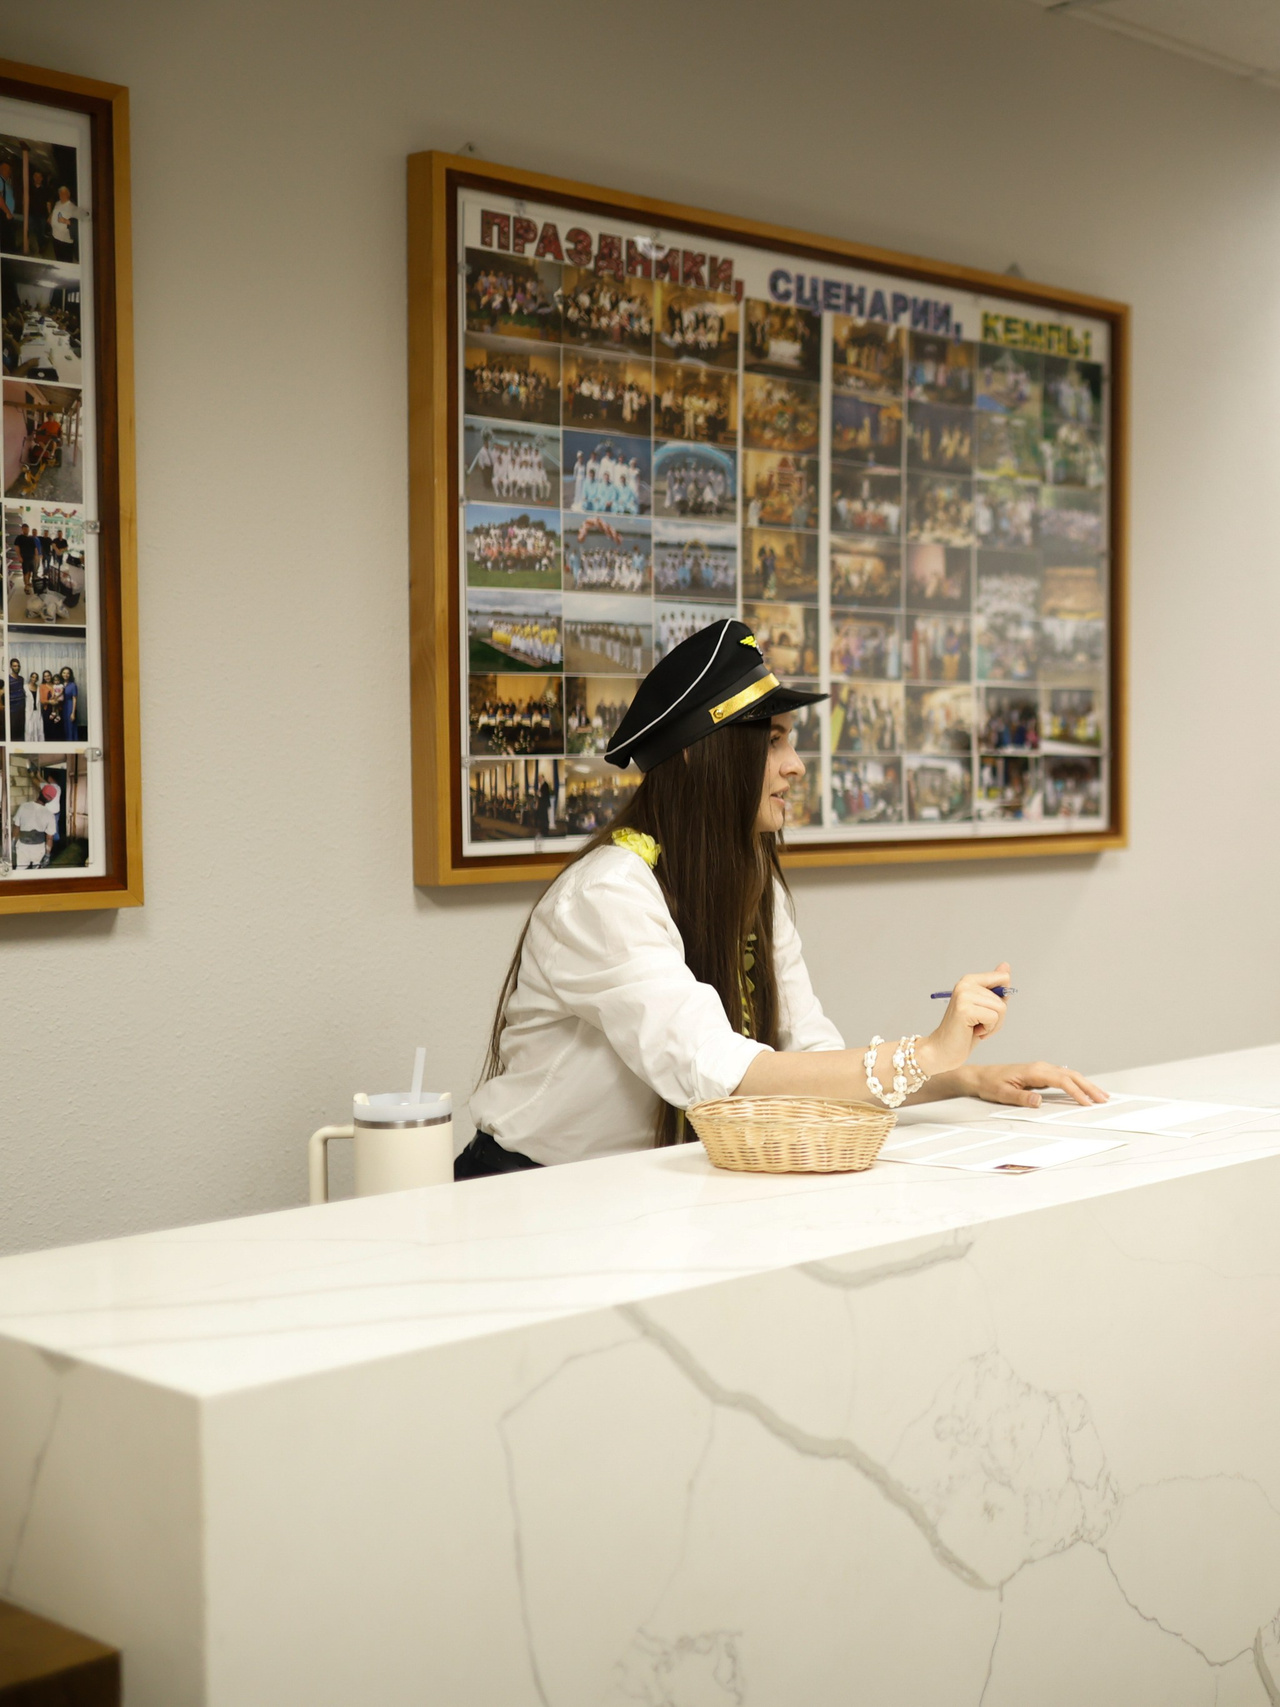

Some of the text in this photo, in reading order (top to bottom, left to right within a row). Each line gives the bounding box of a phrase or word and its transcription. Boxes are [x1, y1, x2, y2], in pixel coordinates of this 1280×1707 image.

[480, 208, 1094, 359] ПРАЗДНИКИ, СЦЕНАРИИ, КЕМПЫ
